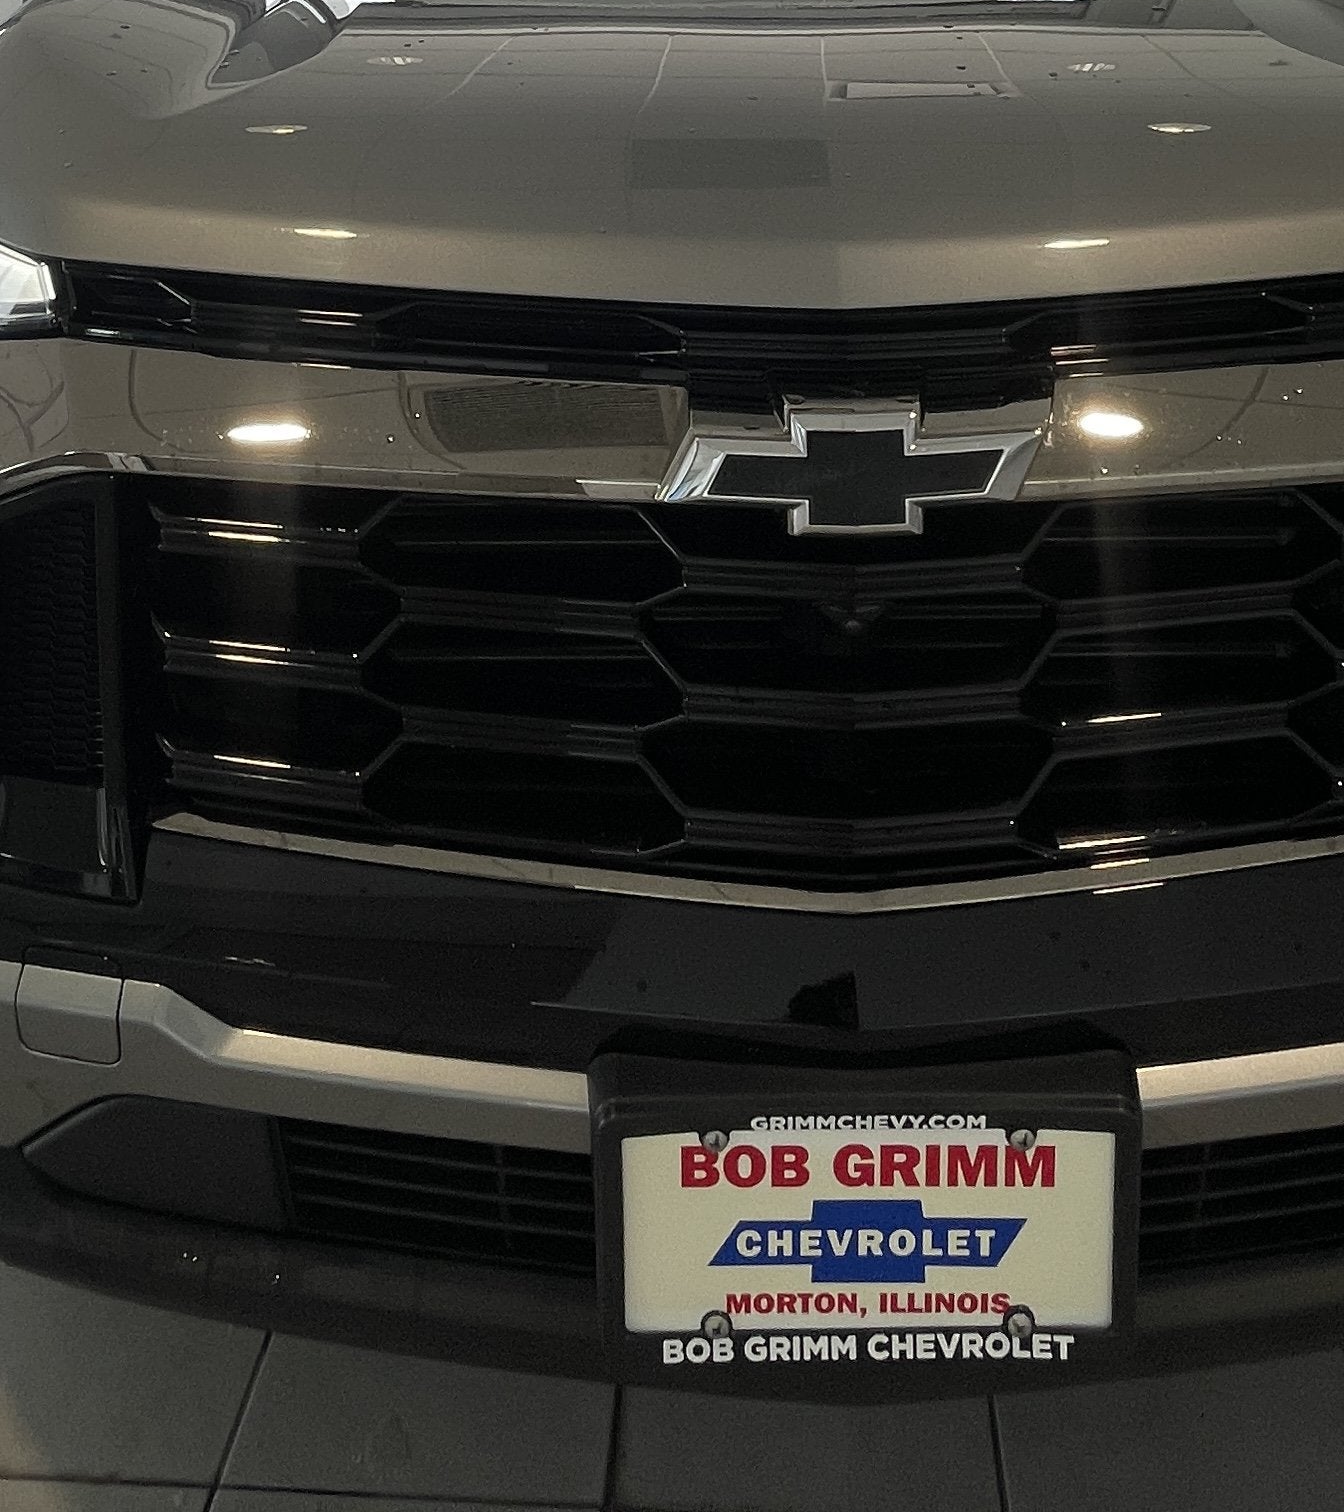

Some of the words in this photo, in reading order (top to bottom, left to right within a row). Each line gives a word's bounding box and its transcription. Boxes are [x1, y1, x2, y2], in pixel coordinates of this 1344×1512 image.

[750, 1114, 987, 1131] GRIMMCHEVY.COM
[680, 1144, 811, 1188] BOB
[832, 1143, 1056, 1188] GRIMM
[736, 1229, 997, 1258] CHEVROLET
[725, 1291, 868, 1319] MORTON,
[879, 1291, 1011, 1315] ILLINOIS
[662, 1336, 735, 1365] BOB
[744, 1333, 857, 1363] GRIMM
[867, 1331, 1075, 1362] CHEVROLET
